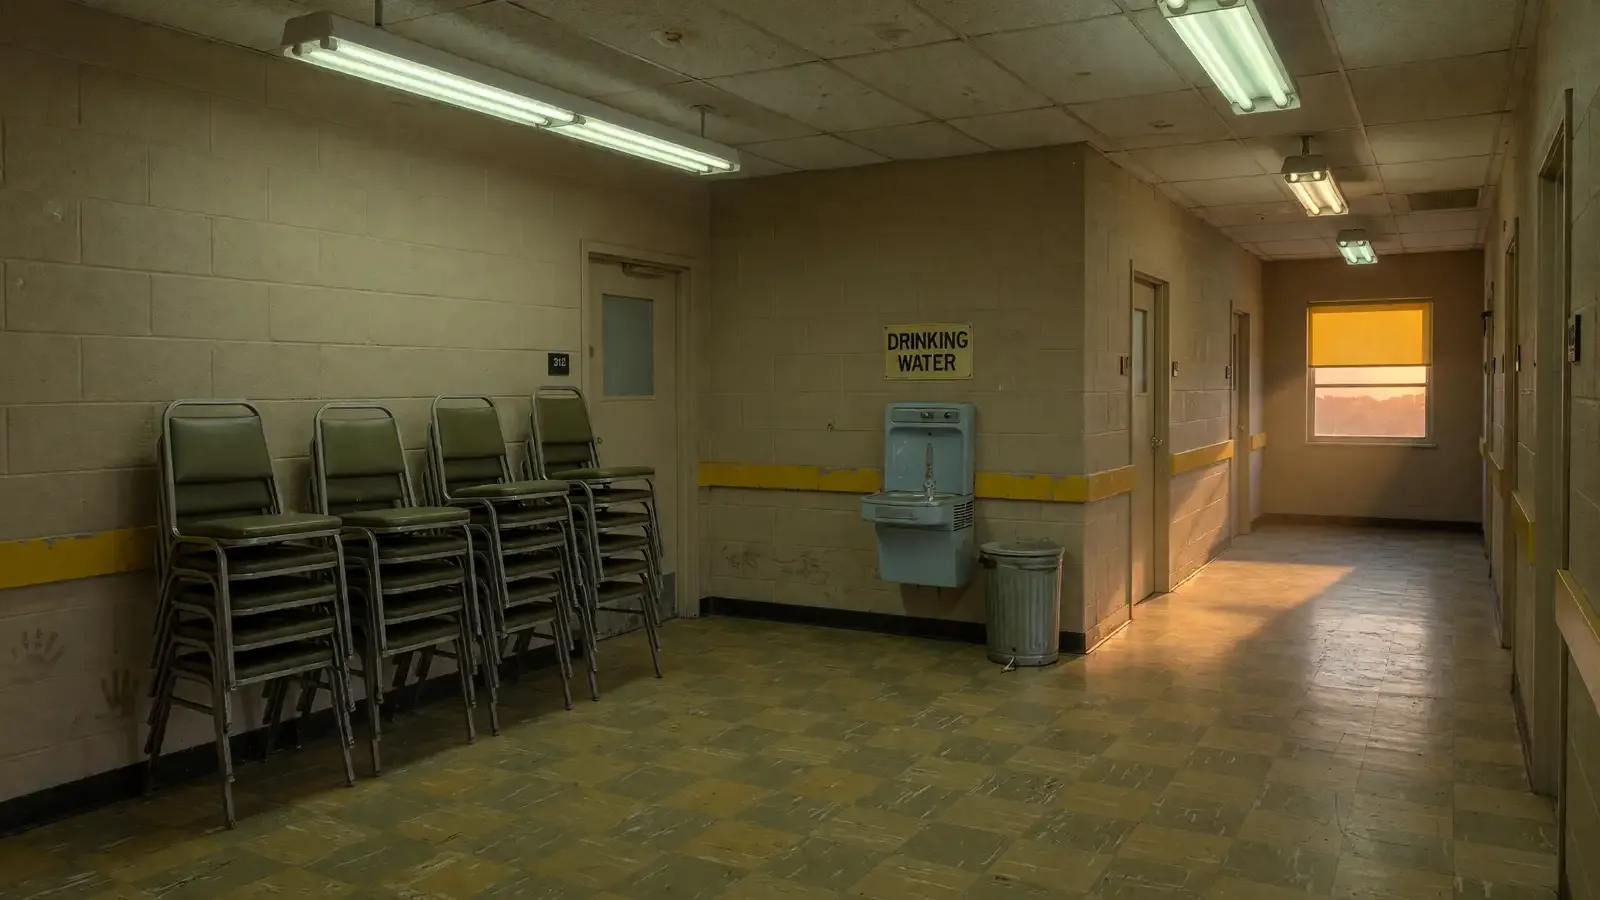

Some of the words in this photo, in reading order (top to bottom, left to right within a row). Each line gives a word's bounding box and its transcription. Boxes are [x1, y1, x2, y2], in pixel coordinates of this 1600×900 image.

[888, 331, 968, 350] DRINKING
[553, 357, 566, 367] 312
[898, 354, 956, 372] WATER
